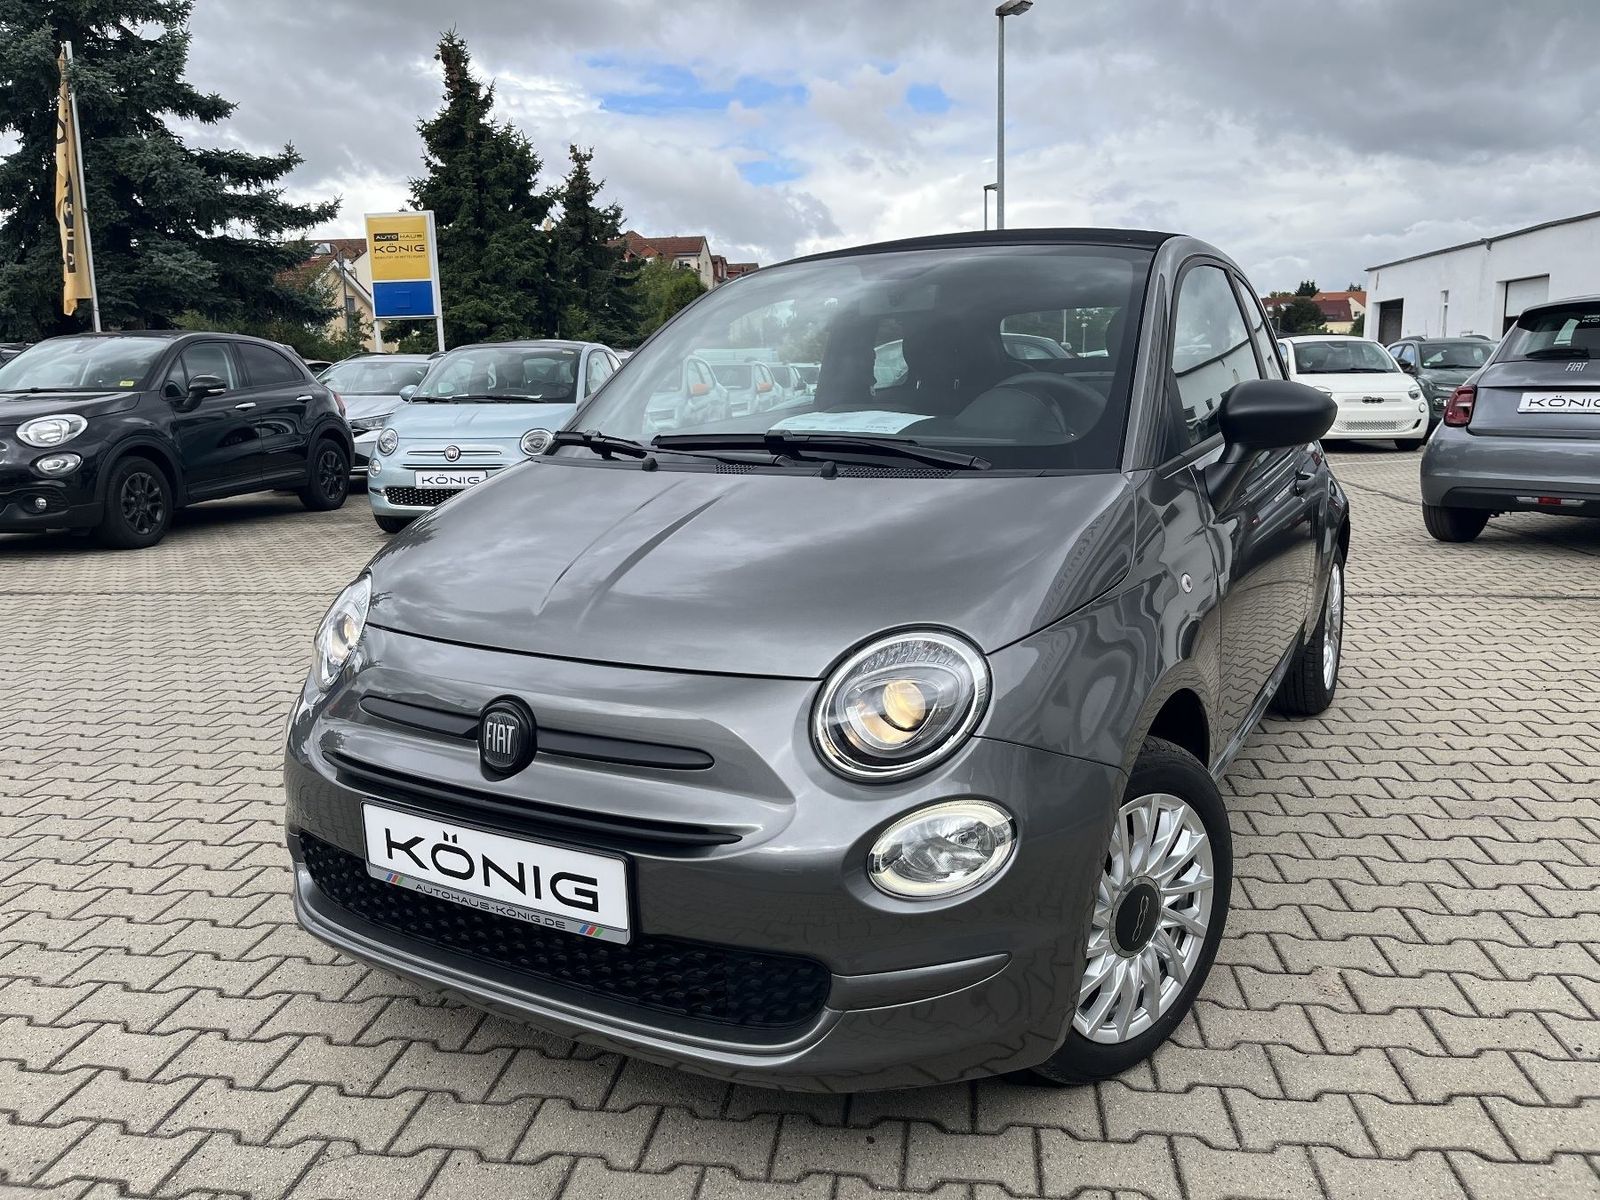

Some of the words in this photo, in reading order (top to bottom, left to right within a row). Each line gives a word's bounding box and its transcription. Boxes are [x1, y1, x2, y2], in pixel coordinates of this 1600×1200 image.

[374, 243, 425, 253] KÖNIG
[1565, 362, 1588, 371] FIAT
[421, 474, 480, 484] KÖNIG
[486, 722, 515, 754] FIAT
[384, 828, 599, 912] KÖNIG
[415, 883, 566, 929] AUTOHAUS-KÖNIG.DE
